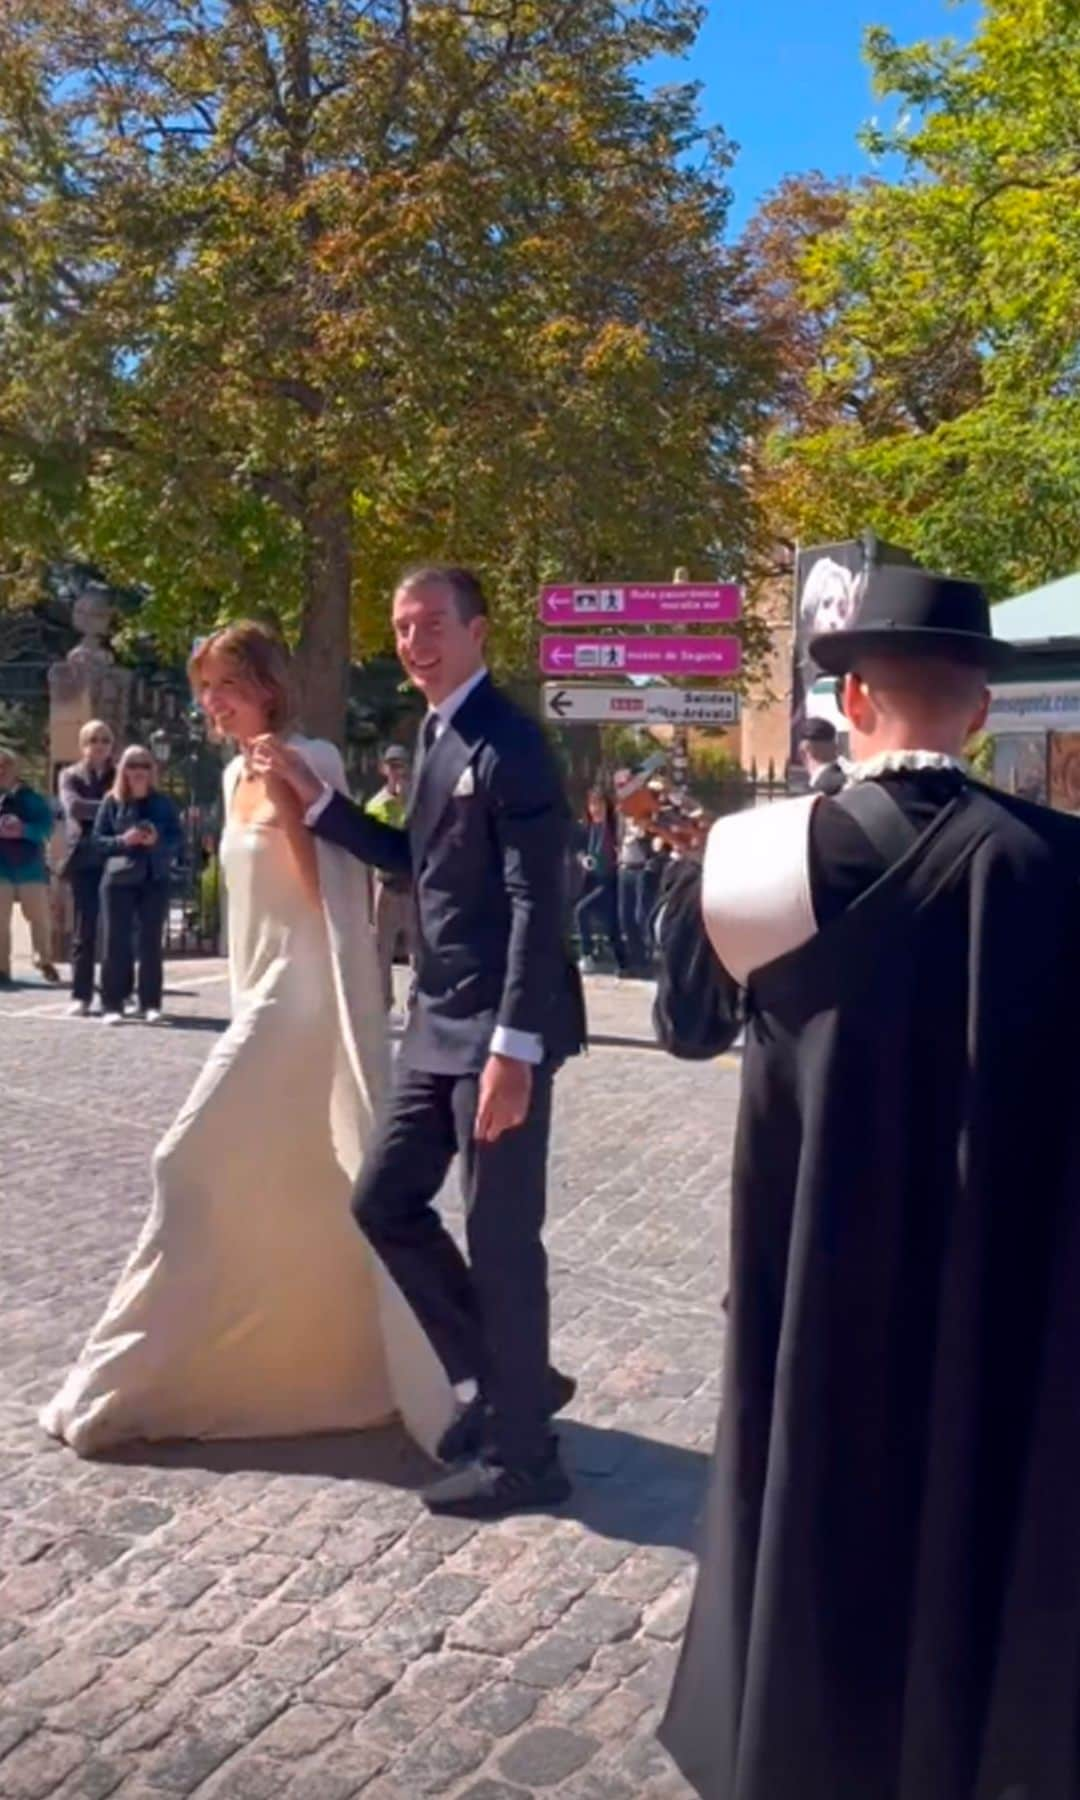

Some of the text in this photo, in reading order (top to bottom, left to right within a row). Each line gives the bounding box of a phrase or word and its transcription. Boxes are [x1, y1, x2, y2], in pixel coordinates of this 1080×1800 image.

[630, 589, 656, 599] Ruta
[665, 651, 678, 661] de
[680, 650, 723, 663] Segovia
[684, 692, 732, 703] Salidas
